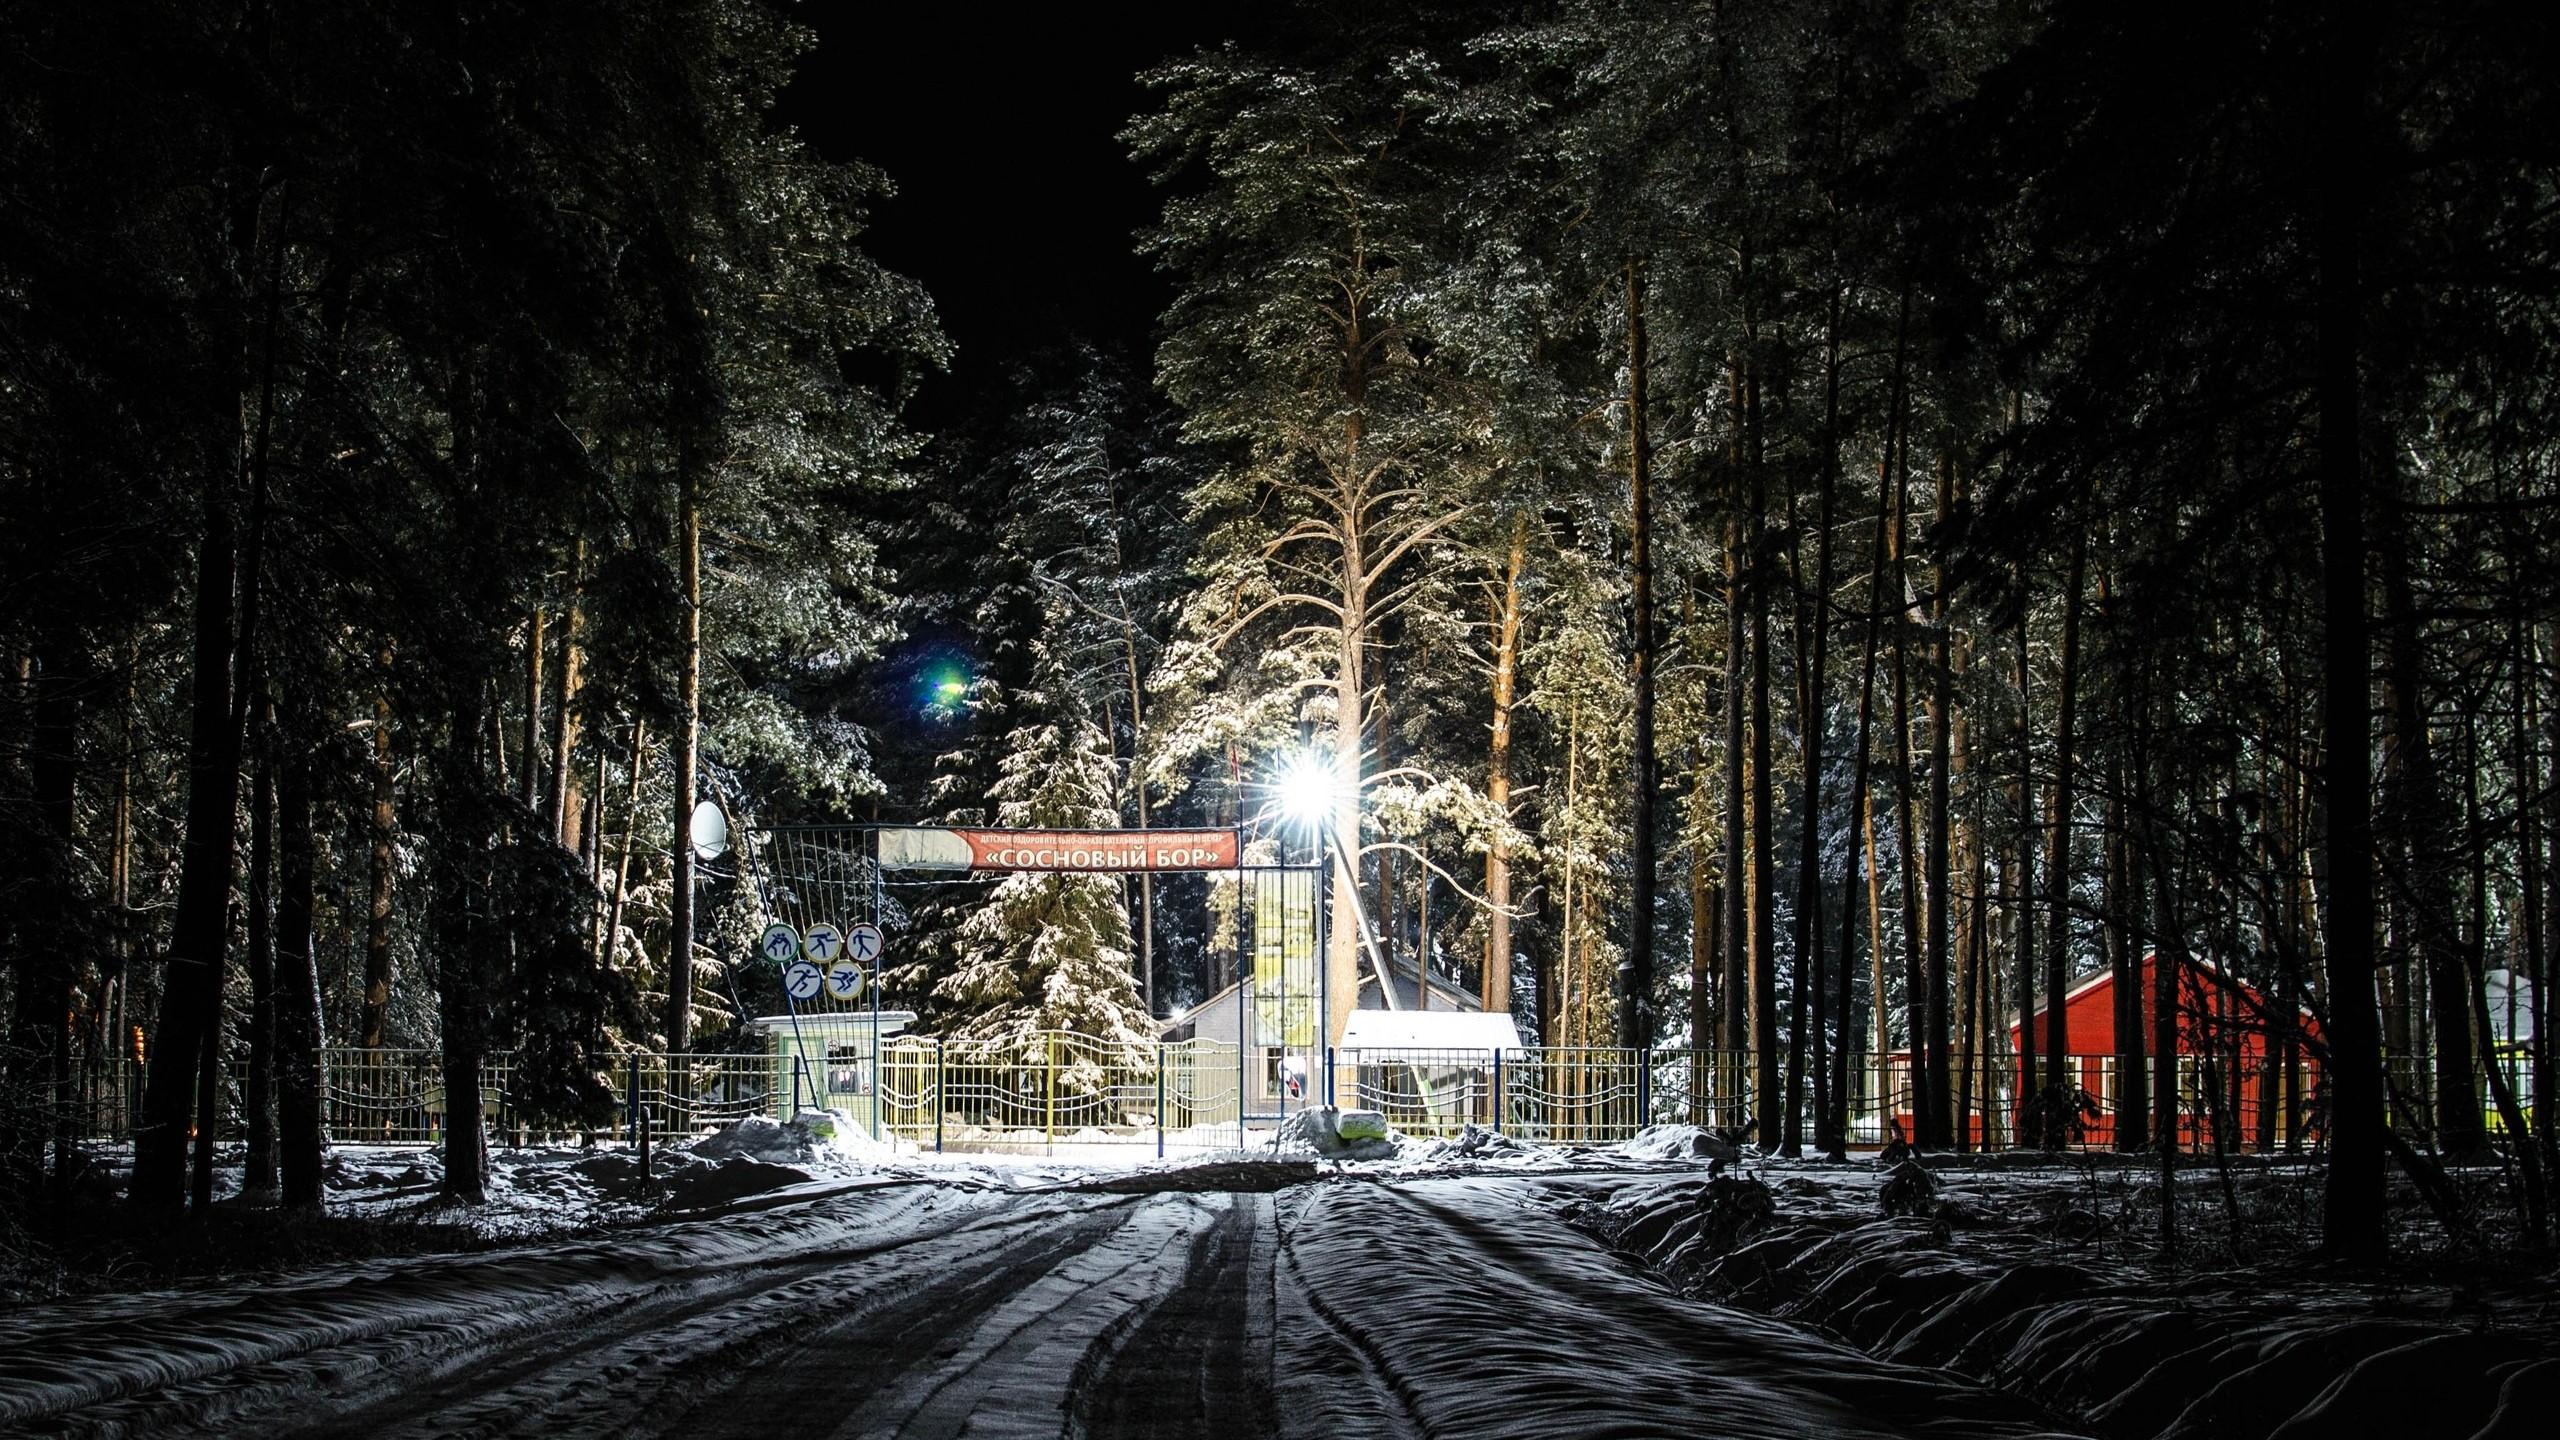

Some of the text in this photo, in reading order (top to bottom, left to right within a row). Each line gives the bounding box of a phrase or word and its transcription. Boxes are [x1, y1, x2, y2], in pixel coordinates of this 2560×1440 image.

[980, 834, 1012, 844] ДЕТСКИЙ
[985, 845, 1219, 867] «СОСНОВЫЙ БОР»
